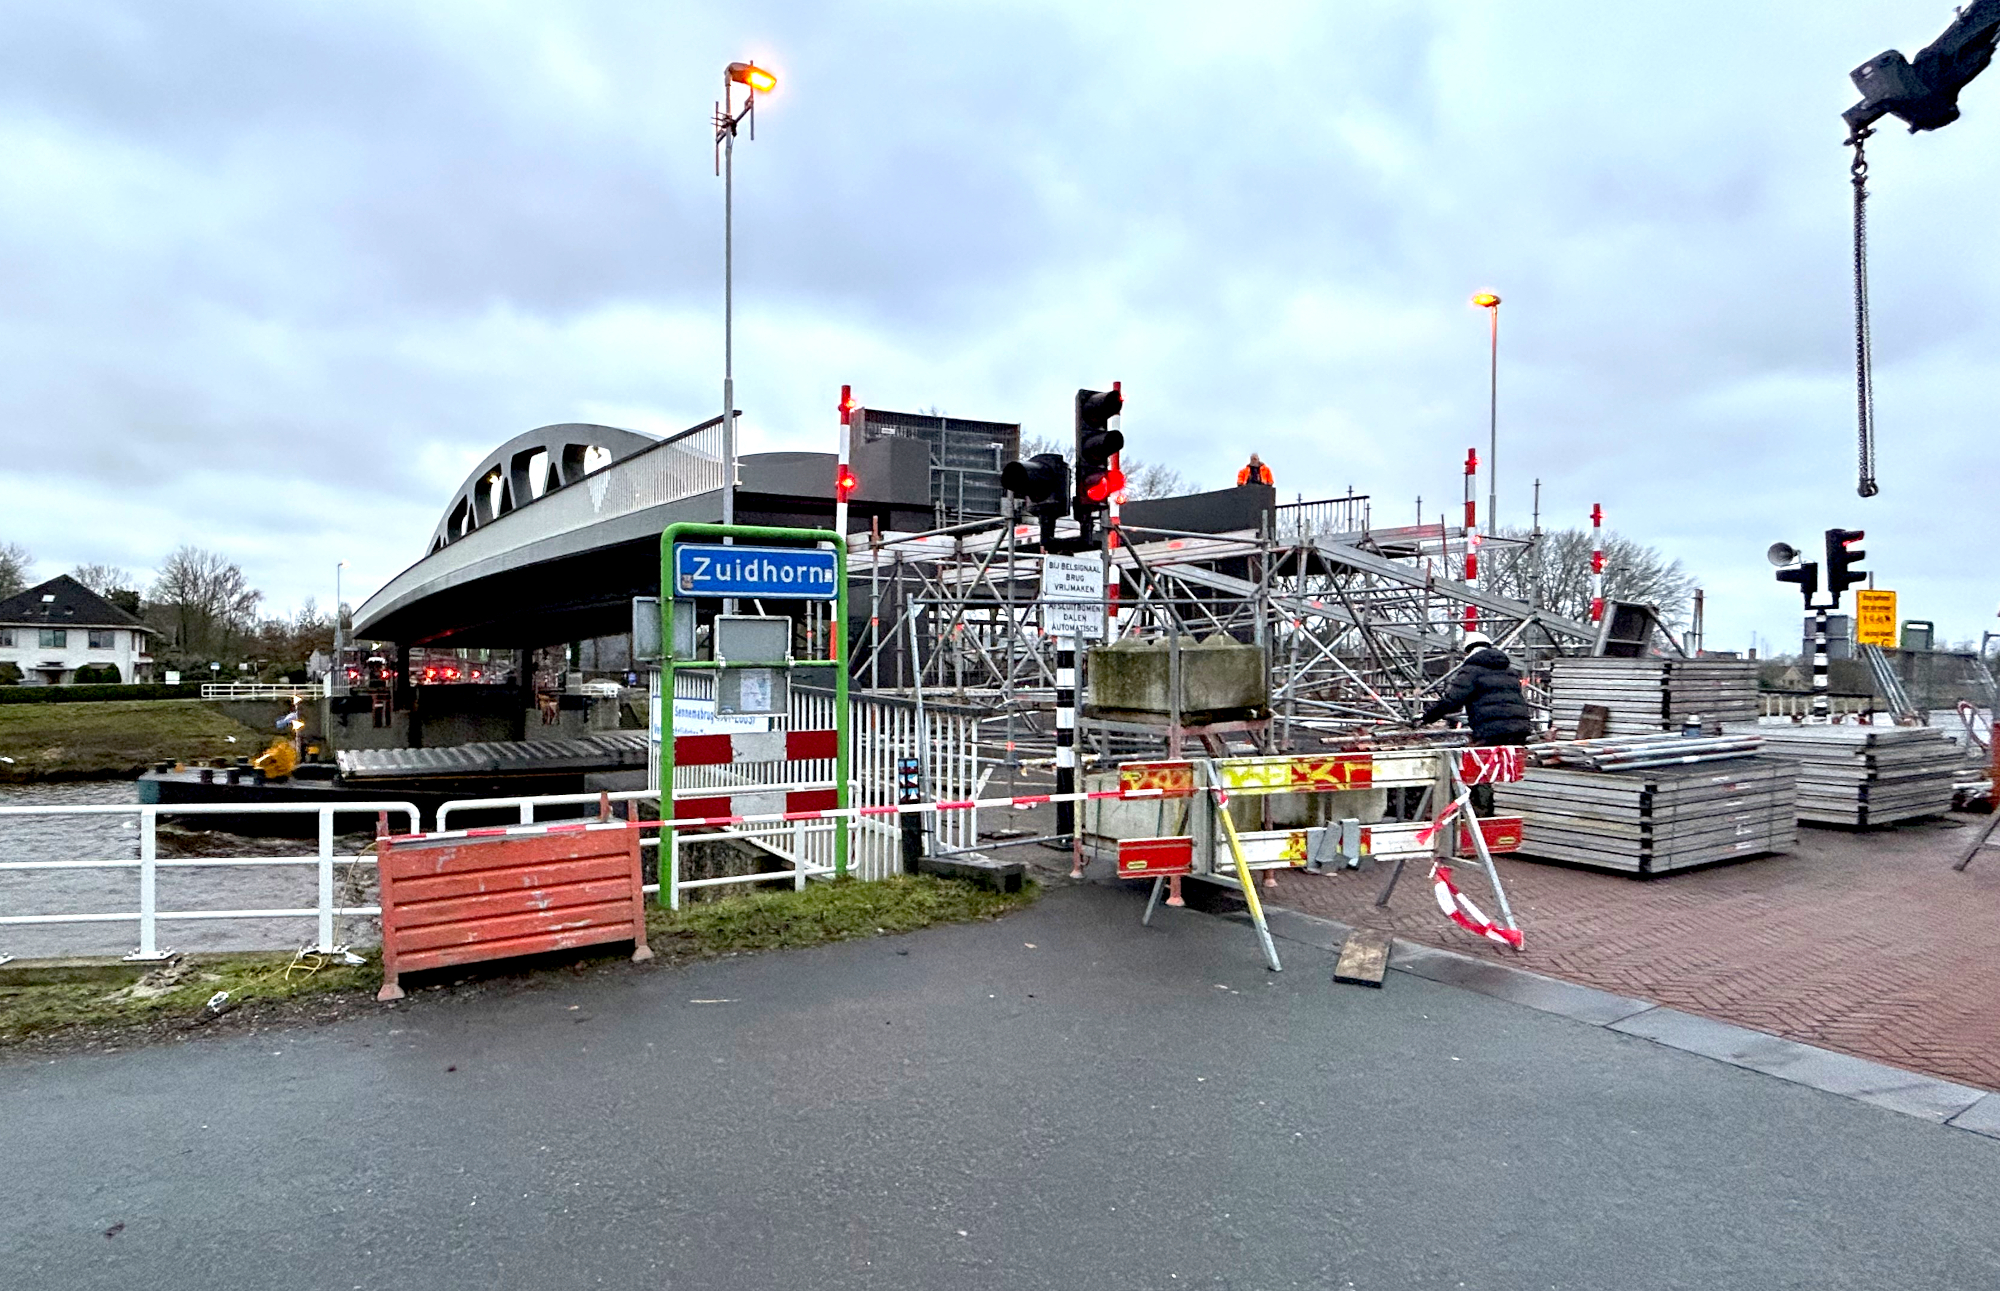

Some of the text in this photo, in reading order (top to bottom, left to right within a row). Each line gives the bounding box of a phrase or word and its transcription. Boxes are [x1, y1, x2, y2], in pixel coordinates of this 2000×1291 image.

[692, 557, 824, 584] Zuidhorn
[1061, 562, 1101, 573] BELSIGNAAL
[1066, 573, 1085, 582] BRUG
[1054, 584, 1095, 593] VRIJMAKEN
[1064, 613, 1087, 621] DALEN
[1052, 623, 1099, 632] AUTOMATISCH
